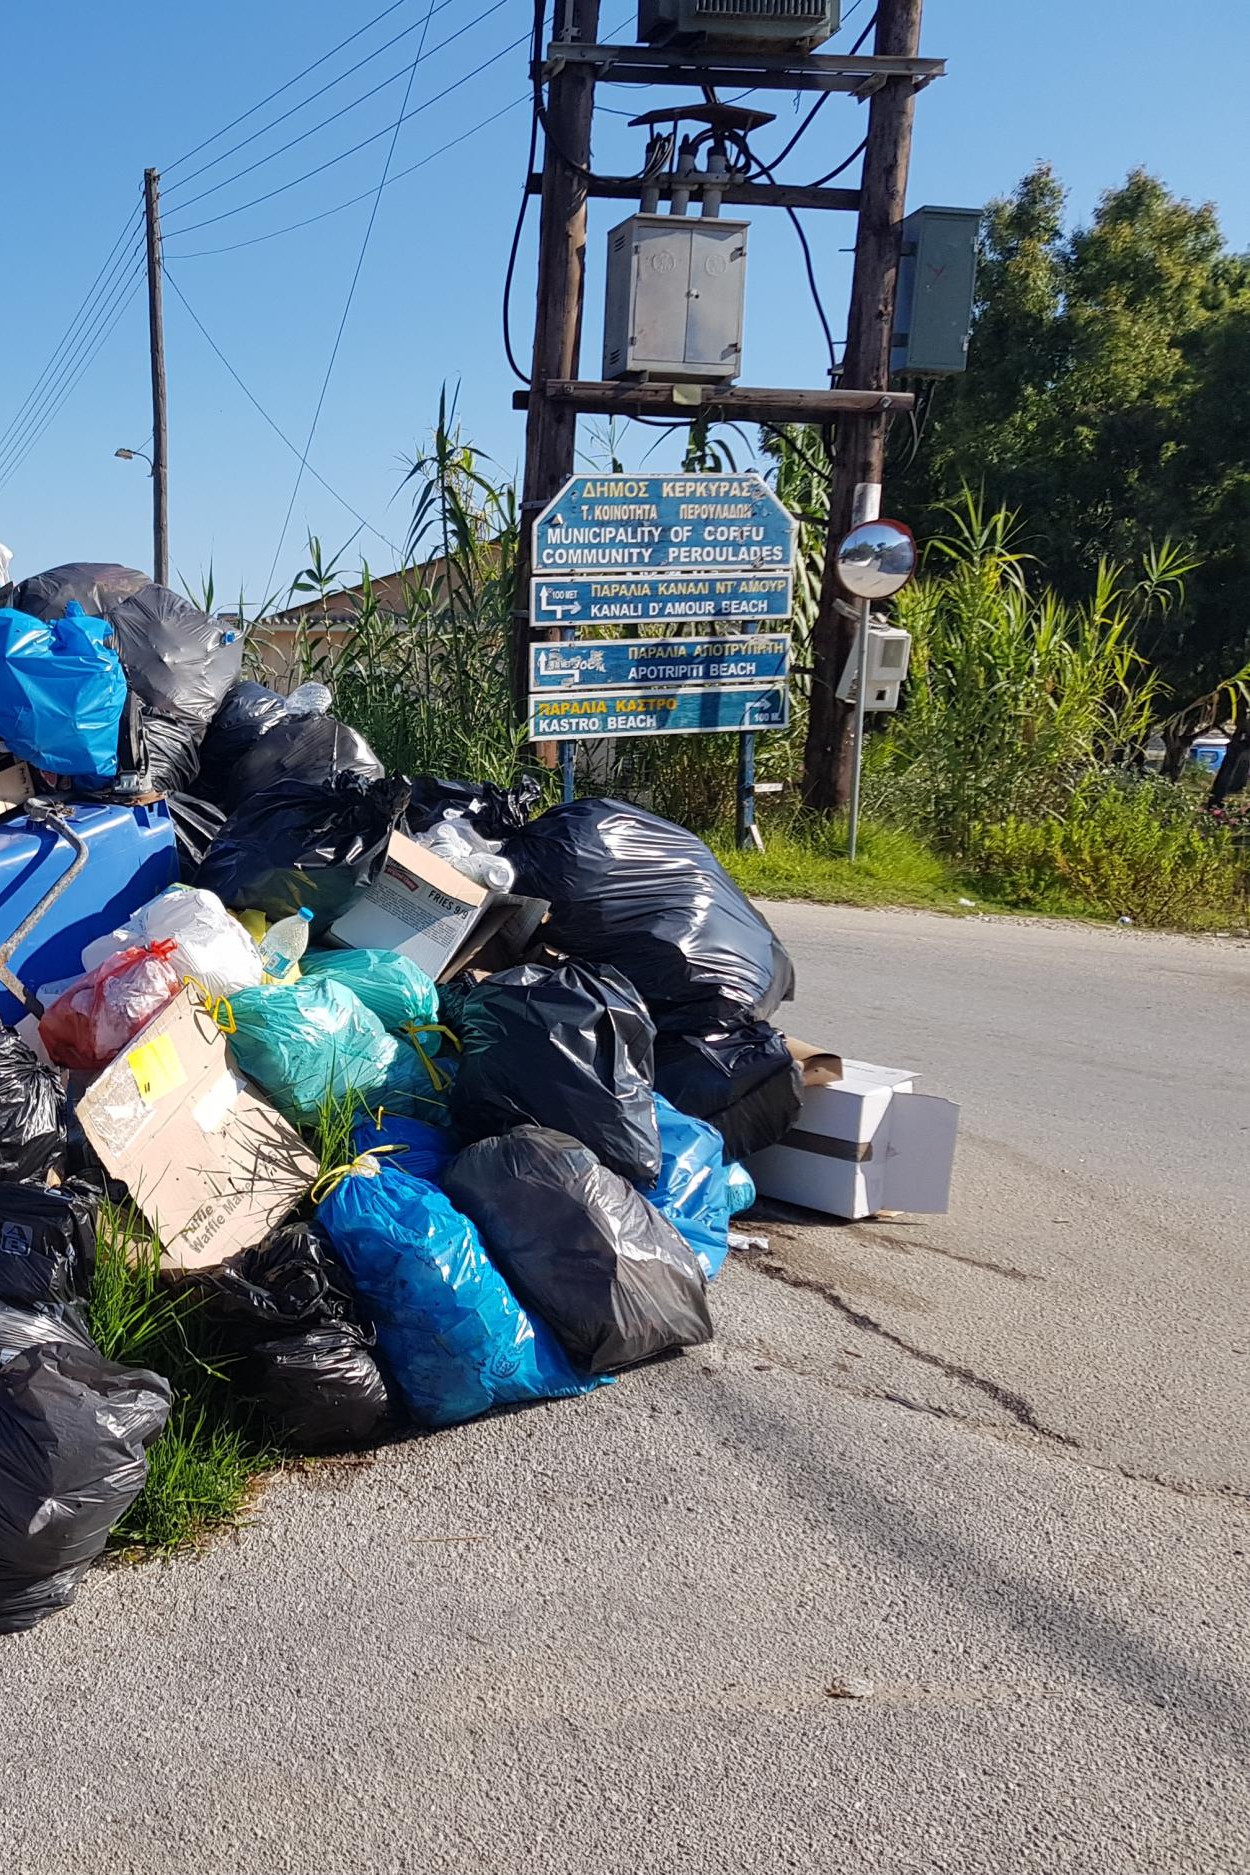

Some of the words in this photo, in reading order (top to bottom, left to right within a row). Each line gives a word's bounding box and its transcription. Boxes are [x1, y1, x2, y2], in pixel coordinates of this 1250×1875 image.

[582, 482, 649, 498] ΔΗΜΟΣ
[662, 481, 752, 498] ΚΕΡΚΥΡΑΣ
[547, 526, 663, 545] MUNICIPALITY
[670, 526, 693, 543] OF
[703, 525, 765, 542] CORFU
[542, 548, 654, 565] COMMUNITY
[668, 545, 784, 563] PEROULADES
[552, 590, 565, 600] 100
[590, 582, 652, 598] ΠΑΡΑΛΙΑ
[658, 581, 709, 596] ΚΑΝΑΛΙ
[590, 603, 643, 617] KANALI
[721, 599, 768, 614] BEACH
[628, 645, 687, 660] ΠΑΡΑΛΙΑ
[628, 665, 704, 681] APOTRIPITI
[709, 662, 756, 677] BEACH
[538, 700, 608, 717] ΠΑΡΑΛΙΑ
[615, 698, 678, 713] ΚΑΣΤΡΟ
[539, 717, 599, 733] KASTRO
[607, 714, 657, 729] BEACH
[428, 890, 455, 911] FRIES
[453, 905, 469, 920] 9/9
[189, 1214, 226, 1255] Waffle
